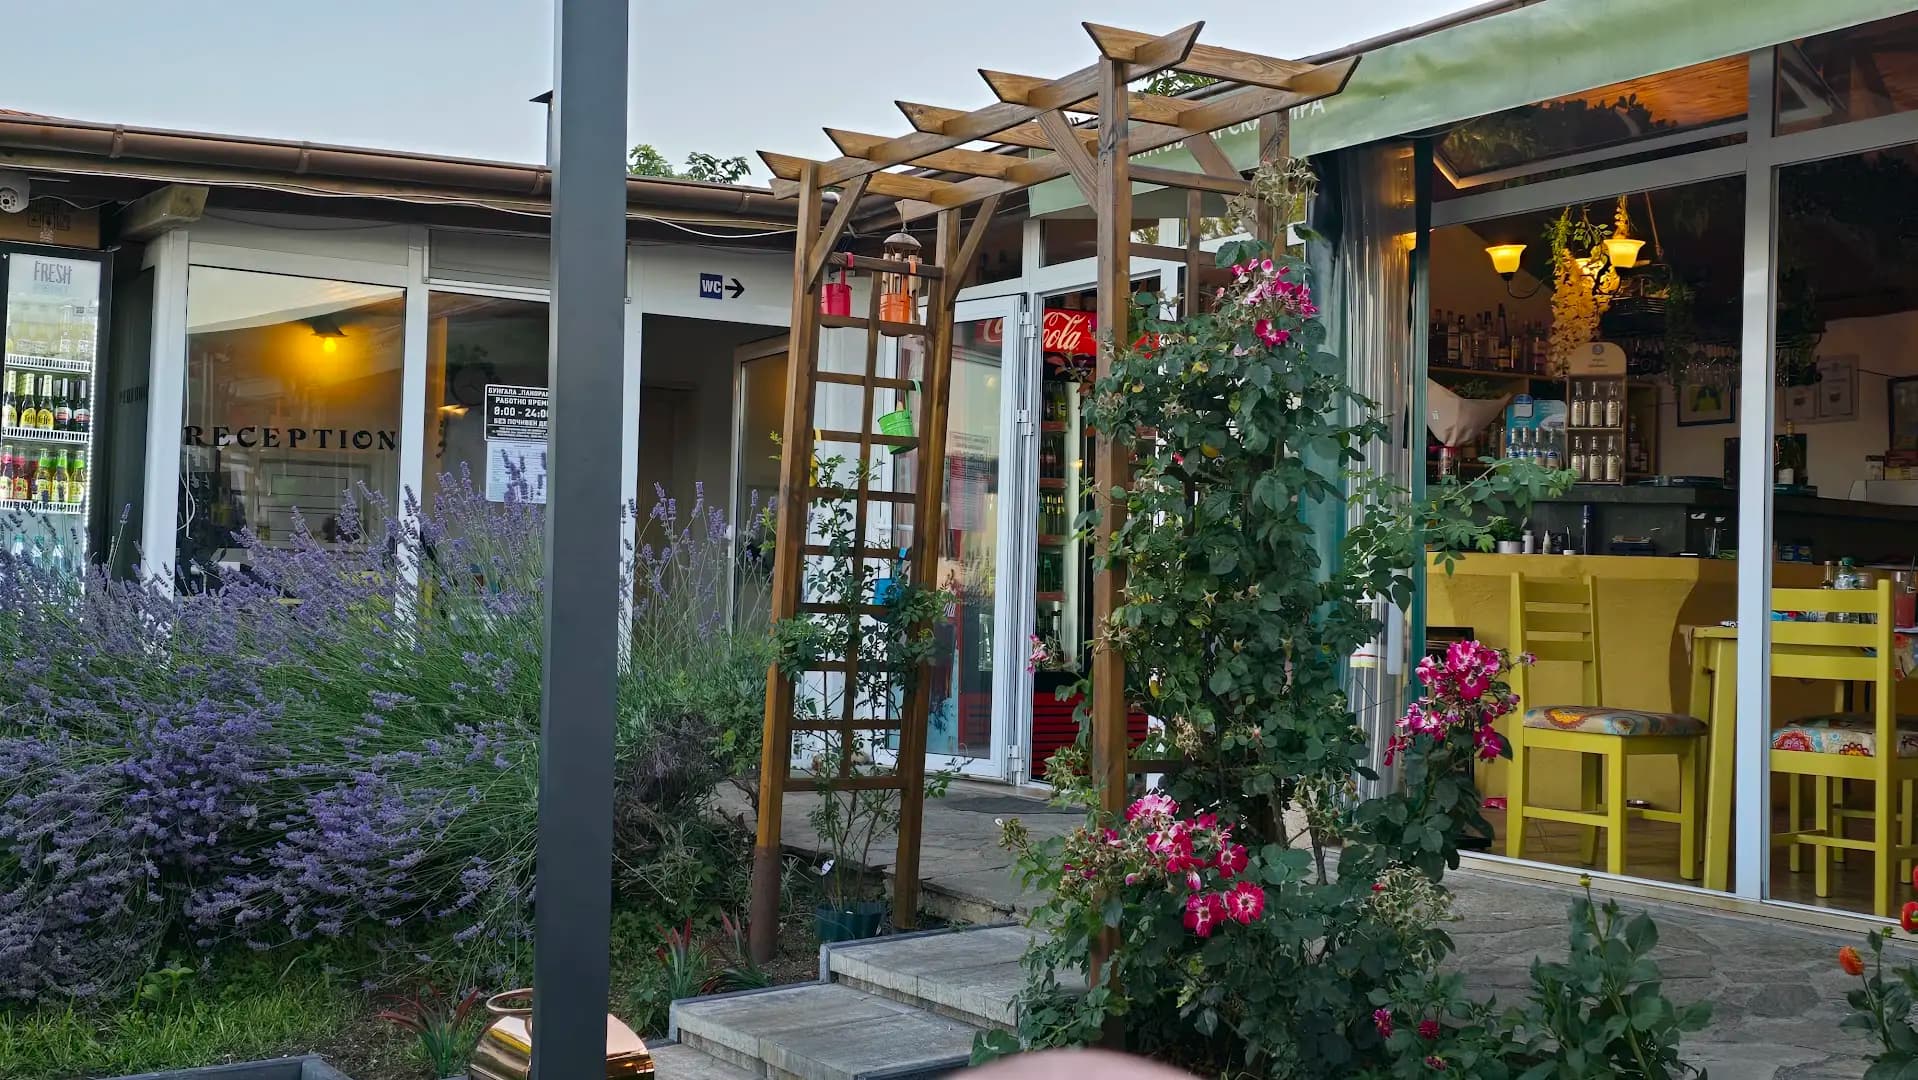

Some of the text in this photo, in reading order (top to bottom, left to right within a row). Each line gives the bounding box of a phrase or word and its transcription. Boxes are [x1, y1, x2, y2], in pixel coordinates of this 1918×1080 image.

[34, 261, 72, 285] FRESH
[702, 279, 722, 294] WC
[495, 397, 527, 405] РАБОТНО
[494, 406, 516, 416] 8:00
[525, 408, 548, 418] 24:0
[183, 425, 397, 451] RECEPTION
